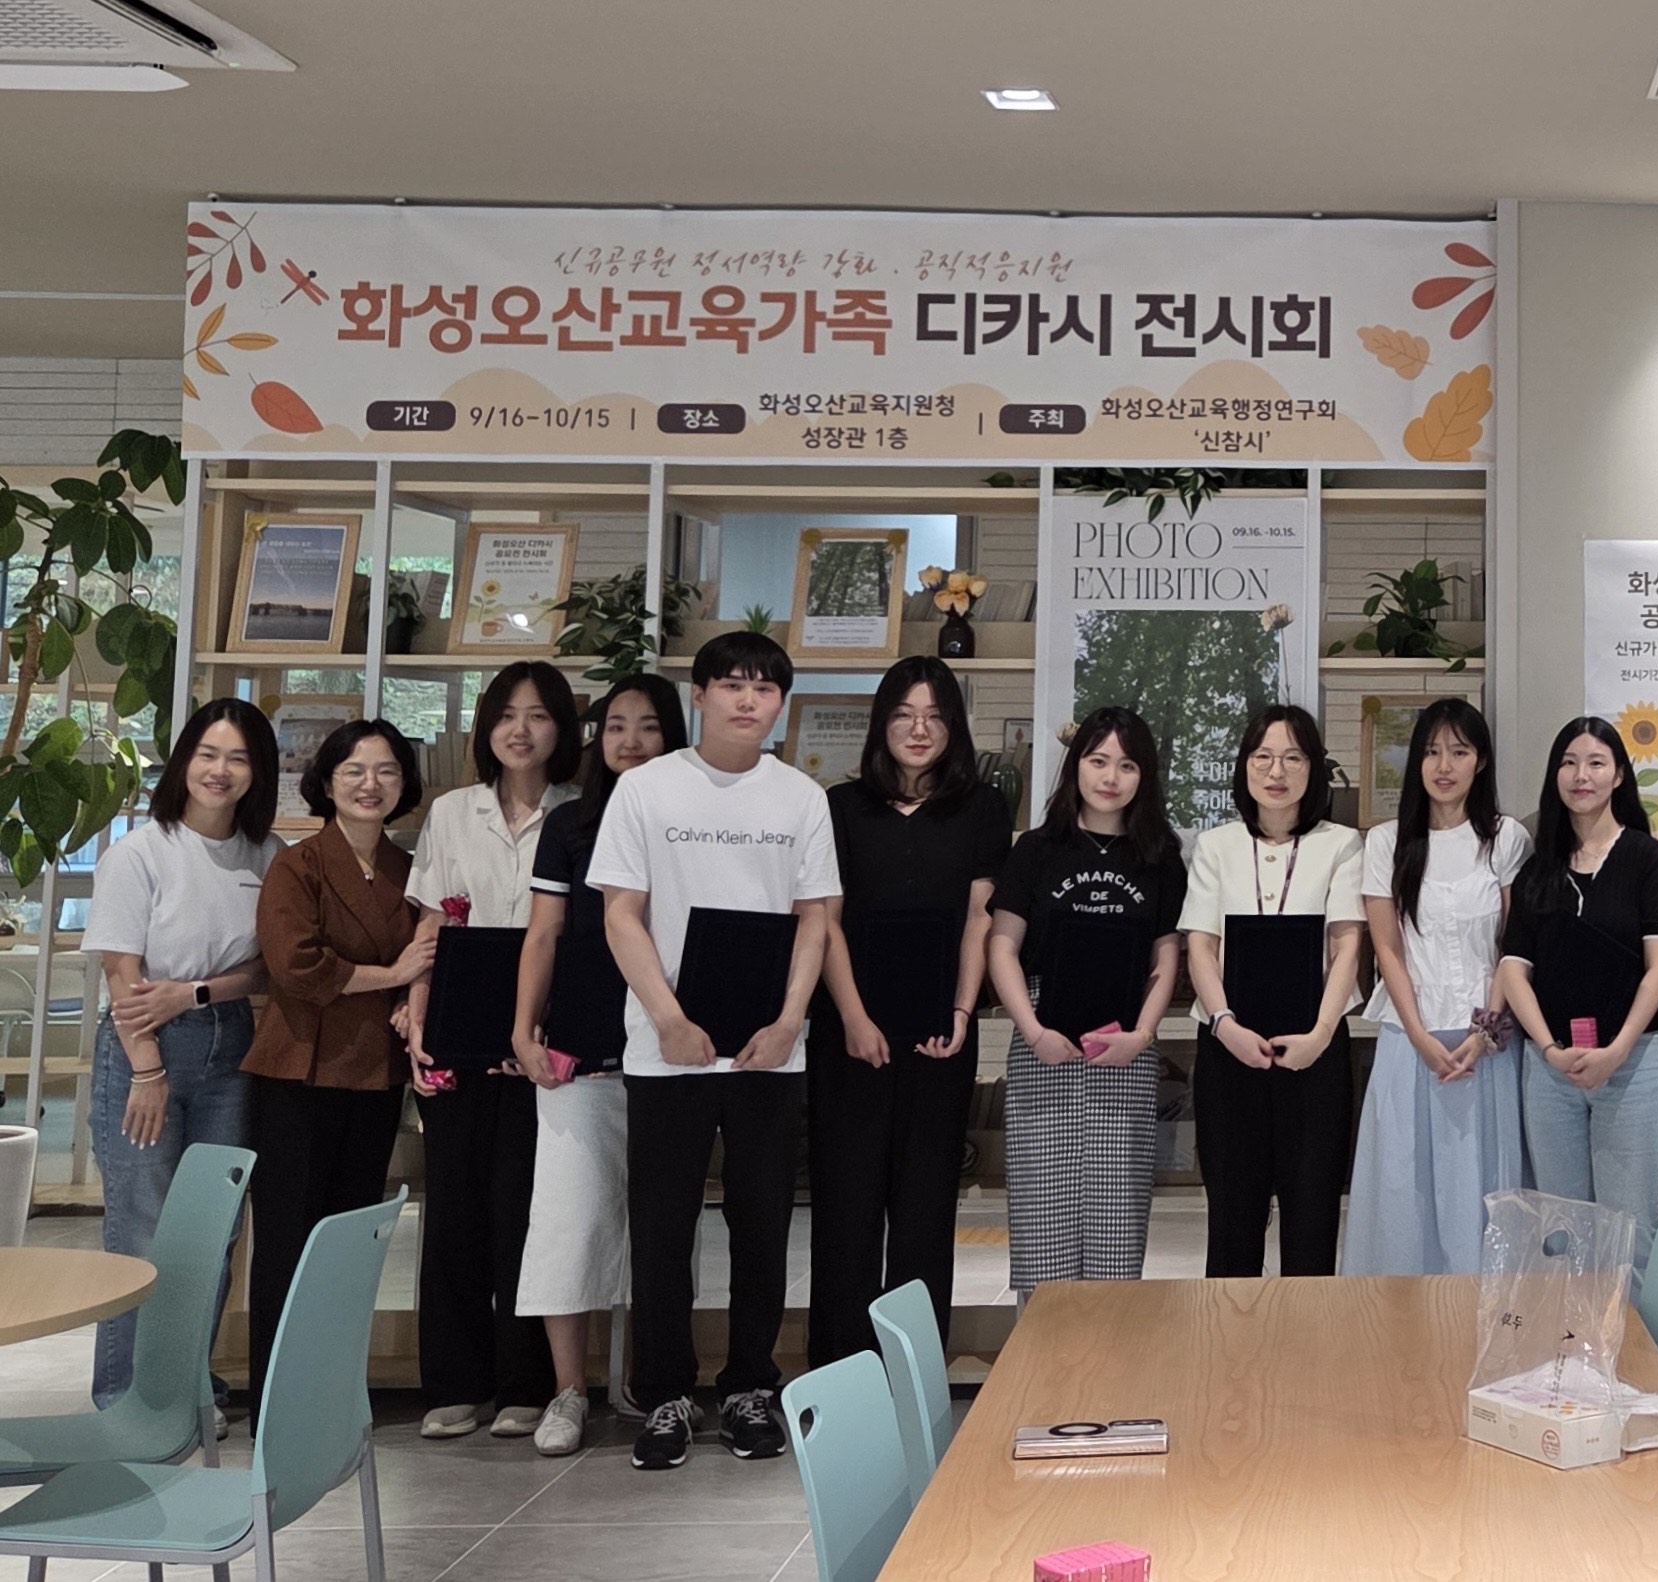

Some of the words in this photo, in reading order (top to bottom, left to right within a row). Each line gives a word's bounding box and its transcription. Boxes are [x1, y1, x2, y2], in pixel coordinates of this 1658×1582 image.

[554, 246, 677, 279] 신규공무원
[692, 249, 807, 279] 정서역량
[823, 249, 879, 279] 강화
[915, 249, 1075, 283] 공직적응지원
[336, 280, 893, 356] 화성오산교육가족
[915, 291, 1113, 357] 디카시
[1133, 292, 1332, 360] 전시회
[393, 405, 430, 427] 기간
[758, 392, 956, 417] 화성오산교육지원청
[1100, 397, 1337, 421] 화성오산교육행정연구회
[469, 406, 610, 429] 9/16-10/15
[683, 408, 720, 430] 장소
[1028, 408, 1065, 429] 주최
[801, 426, 866, 450] 성장관
[877, 427, 909, 450] 1층
[1073, 521, 1222, 559] PHOTO
[1072, 566, 1269, 600] EXHIBITION
[1615, 641, 1658, 657] 신규가
[665, 826, 713, 843] Calvin
[716, 829, 753, 845] Klein
[1051, 878, 1075, 899] LE
[1076, 870, 1145, 904] MARCHE
[1090, 891, 1110, 901] DE
